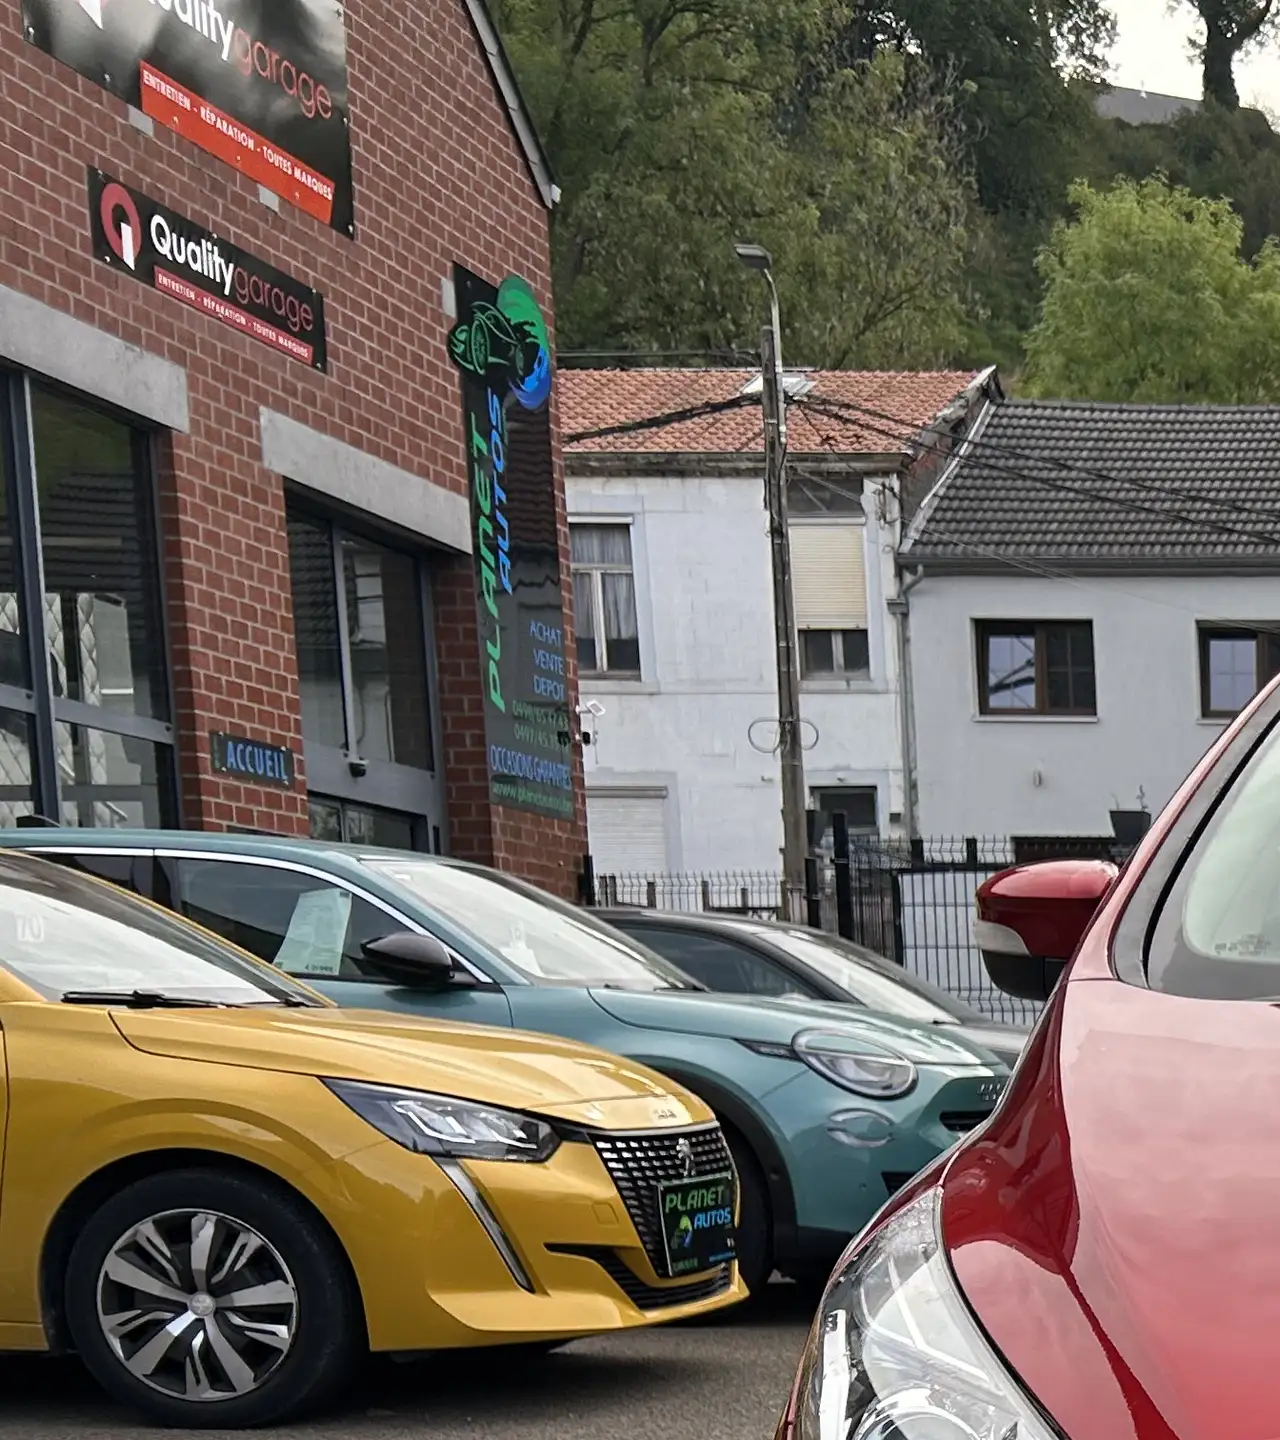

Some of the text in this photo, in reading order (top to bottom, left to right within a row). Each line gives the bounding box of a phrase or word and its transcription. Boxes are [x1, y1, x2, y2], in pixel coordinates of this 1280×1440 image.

[154, 0, 332, 119] alitygarage
[142, 70, 191, 112] ENTRETIEN
[200, 104, 255, 150] RÉPARATION
[262, 145, 293, 175] TOUTES
[293, 166, 333, 201] MARQUES
[158, 273, 196, 301] ENTRETIEN
[253, 321, 276, 342] TOUTES
[487, 386, 513, 595] AUTOS
[470, 411, 506, 713] PLANET
[530, 620, 562, 647] ACHAT
[533, 648, 564, 676] VENTE
[533, 675, 564, 700] DEPOT
[227, 741, 288, 780] ACCUEIL
[665, 1185, 724, 1214] PLANET
[694, 1208, 731, 1230] AUTOS
